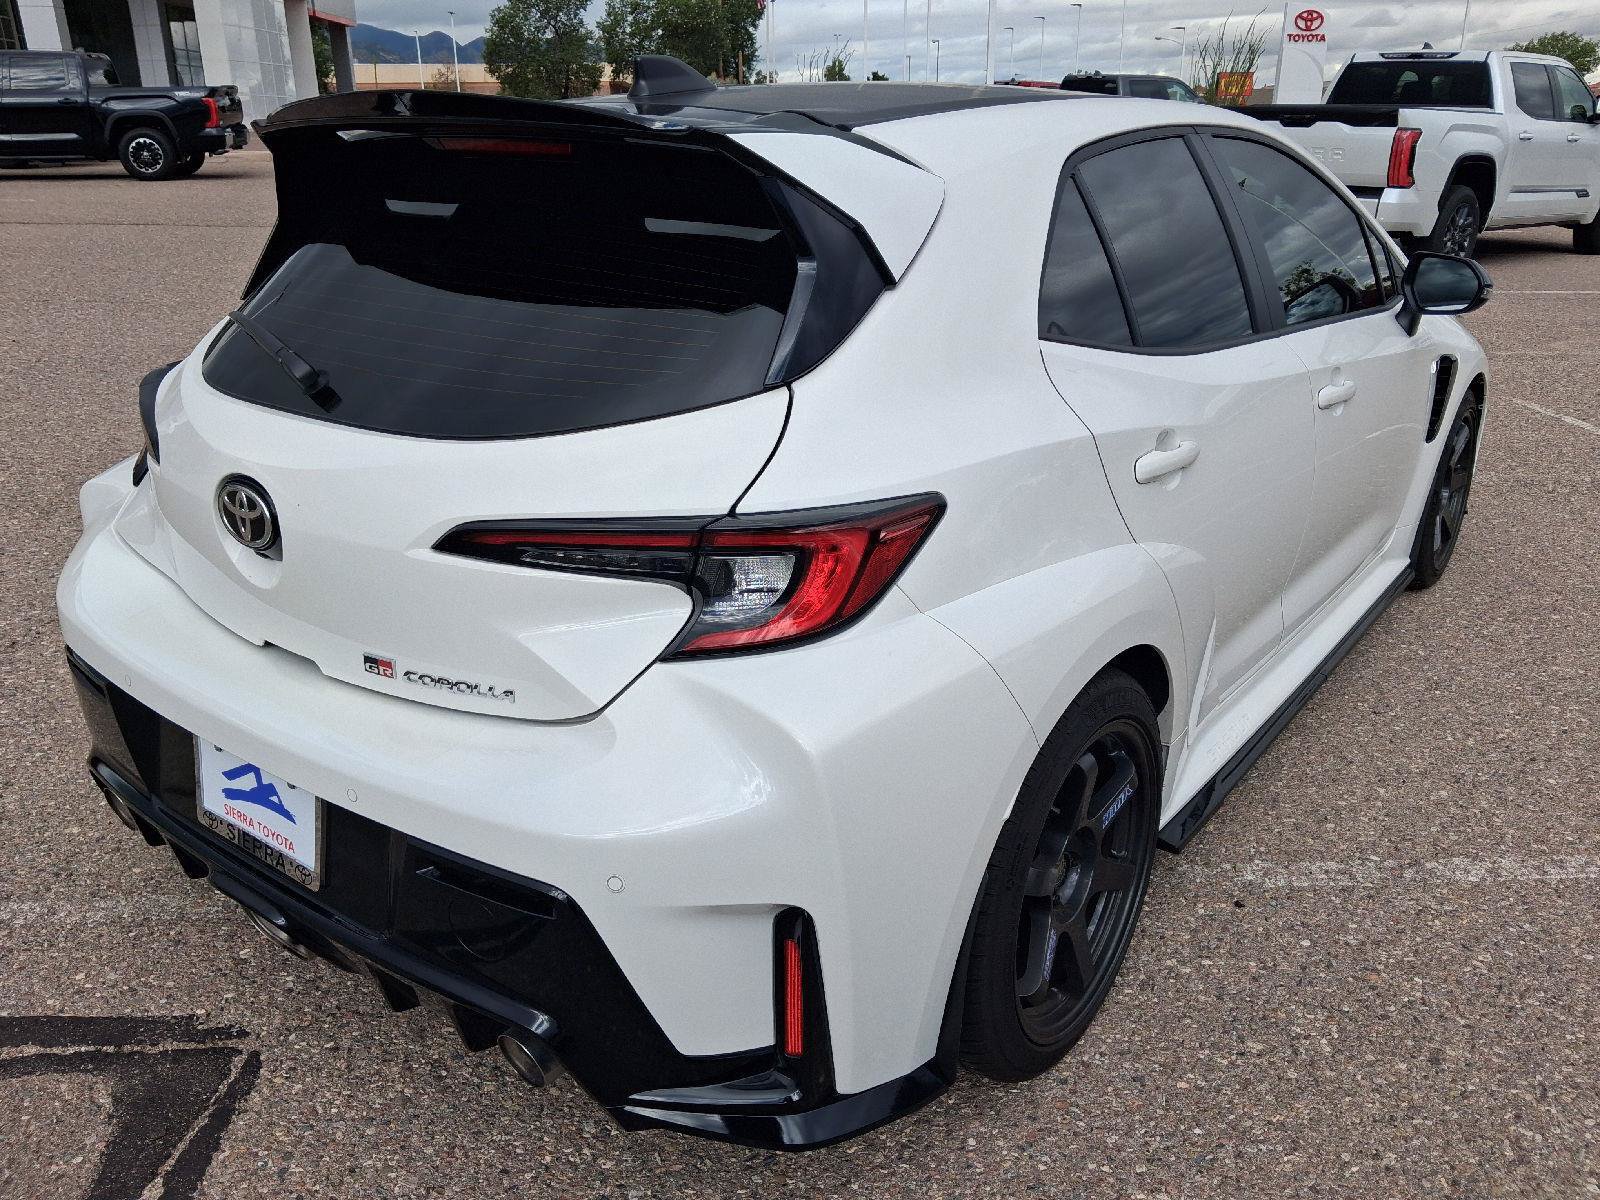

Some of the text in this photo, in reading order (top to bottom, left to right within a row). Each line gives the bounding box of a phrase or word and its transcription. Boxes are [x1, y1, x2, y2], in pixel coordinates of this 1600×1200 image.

[1287, 33, 1326, 42] TOYOTA
[364, 662, 515, 703] GR COROLLA
[223, 803, 296, 853] SIERRA TOYOTA
[226, 824, 286, 873] SIERRA
